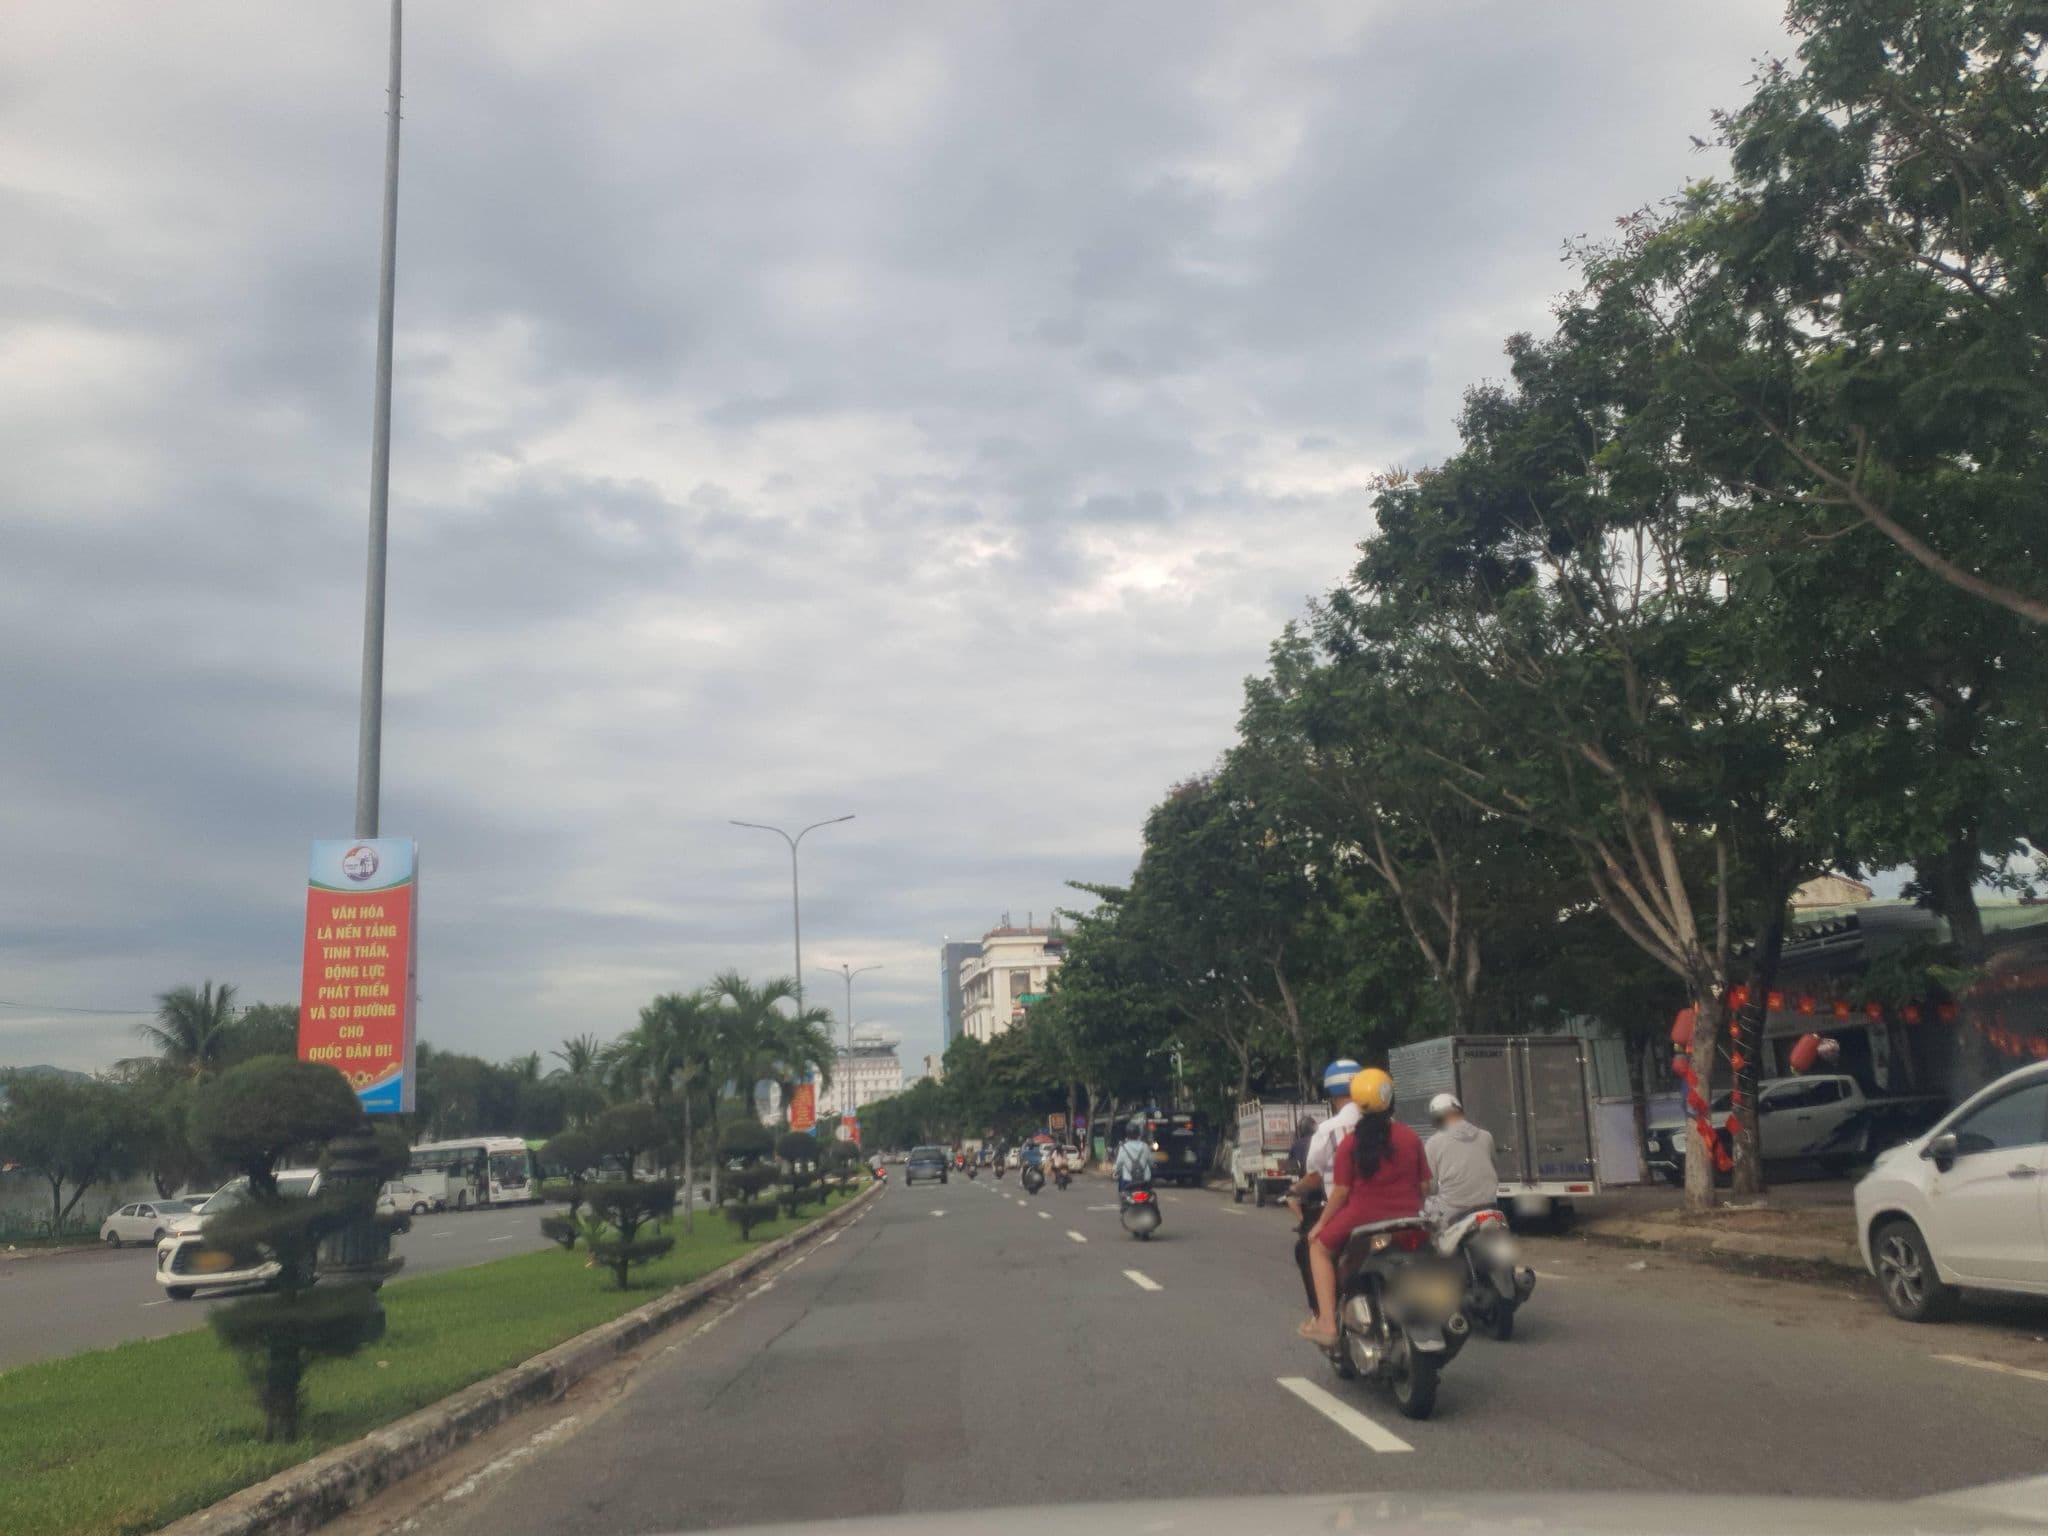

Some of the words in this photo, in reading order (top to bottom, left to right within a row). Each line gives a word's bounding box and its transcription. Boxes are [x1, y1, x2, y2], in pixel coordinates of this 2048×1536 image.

[360, 904, 384, 919] HÓA
[318, 925, 332, 940] LÀ
[365, 923, 397, 938] TẢNG
[323, 946, 350, 959] TINH
[319, 984, 350, 999] PHÁT
[310, 1005, 326, 1020] VÀ
[330, 1006, 350, 1018] SOI
[339, 1026, 364, 1038] CHO
[309, 1042, 342, 1061] QUỐC
[346, 1043, 371, 1058] DÂN
